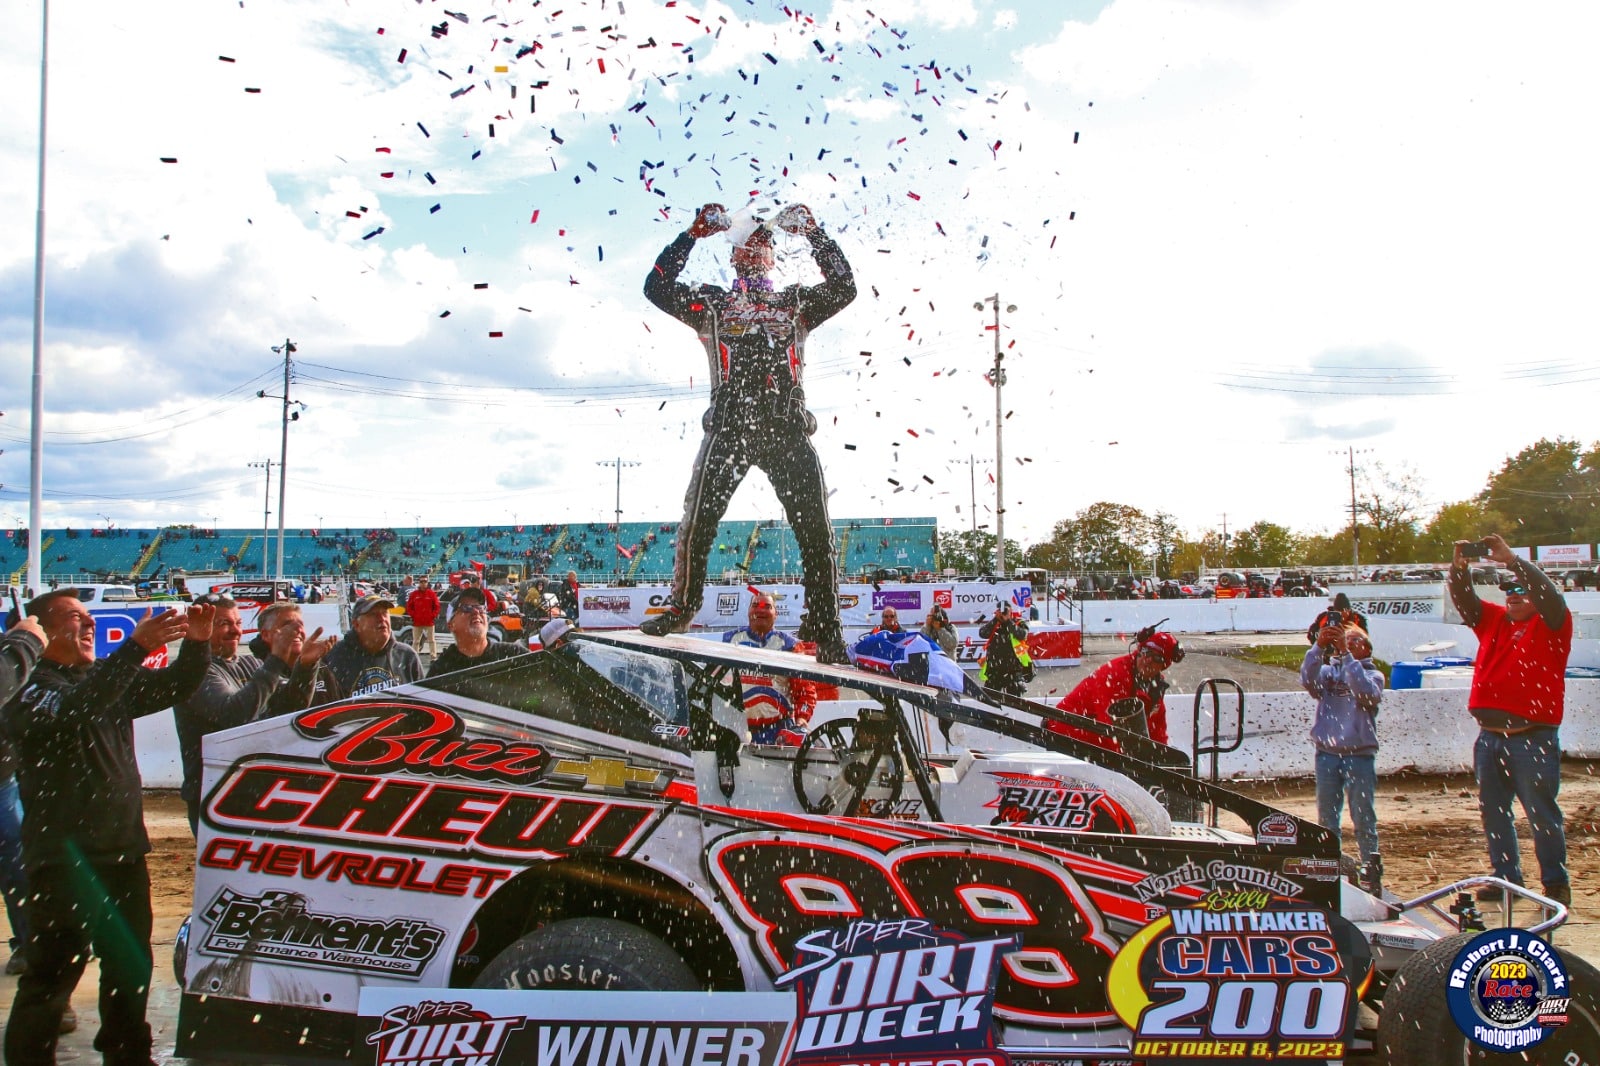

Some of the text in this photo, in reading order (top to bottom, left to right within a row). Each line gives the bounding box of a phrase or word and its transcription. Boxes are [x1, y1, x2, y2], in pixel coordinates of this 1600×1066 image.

[648, 595, 673, 607] CA
[955, 594, 999, 604] TOYOTA
[1367, 602, 1410, 615] 50/50
[297, 701, 545, 774] Buzz
[1001, 787, 1103, 811] BILLY
[1027, 808, 1091, 829] KID
[200, 838, 514, 899] CHEVROLET
[1135, 860, 1304, 902] North Country
[1208, 890, 1272, 911] Billy
[214, 900, 447, 960] Behrent's
[1171, 909, 1328, 934] WHITTAKER
[322, 950, 412, 970] Warehouse
[774, 919, 938, 985] SUPER
[1159, 936, 1338, 977] CARS
[504, 959, 620, 990] Hoosier
[807, 937, 1015, 1015] DIRT
[366, 1001, 473, 1044] SUPER
[794, 995, 989, 1053] WEEK
[1140, 981, 1346, 1038] 200
[384, 1017, 522, 1060] DIRT
[538, 1026, 766, 1066] WINNER
[1135, 1041, 1346, 1060] OCTOBER 8, 2023
